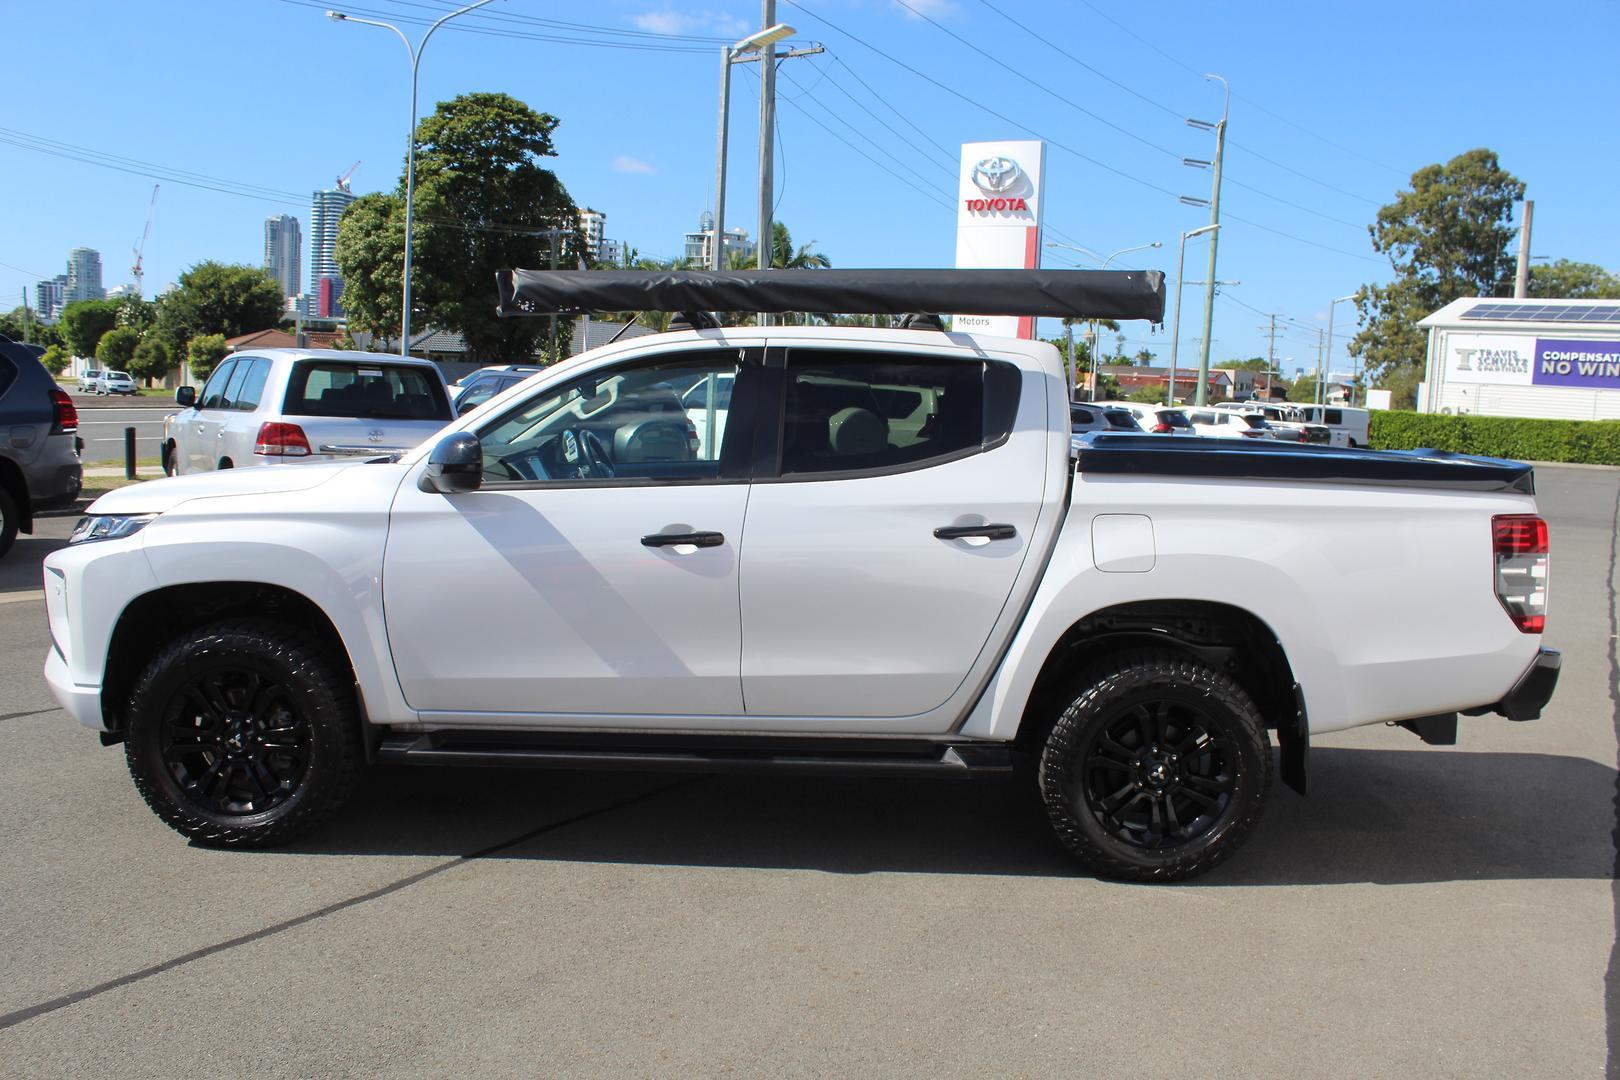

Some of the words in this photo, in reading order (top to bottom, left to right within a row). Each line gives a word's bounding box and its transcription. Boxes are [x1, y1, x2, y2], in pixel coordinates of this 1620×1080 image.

[965, 197, 1027, 212] TOYOTA
[959, 316, 990, 326] Motors
[1479, 349, 1518, 358] TRAVIS
[1478, 357, 1529, 367] SCHULTZ
[1542, 361, 1571, 375] NO
[1578, 363, 1620, 376] WIN
